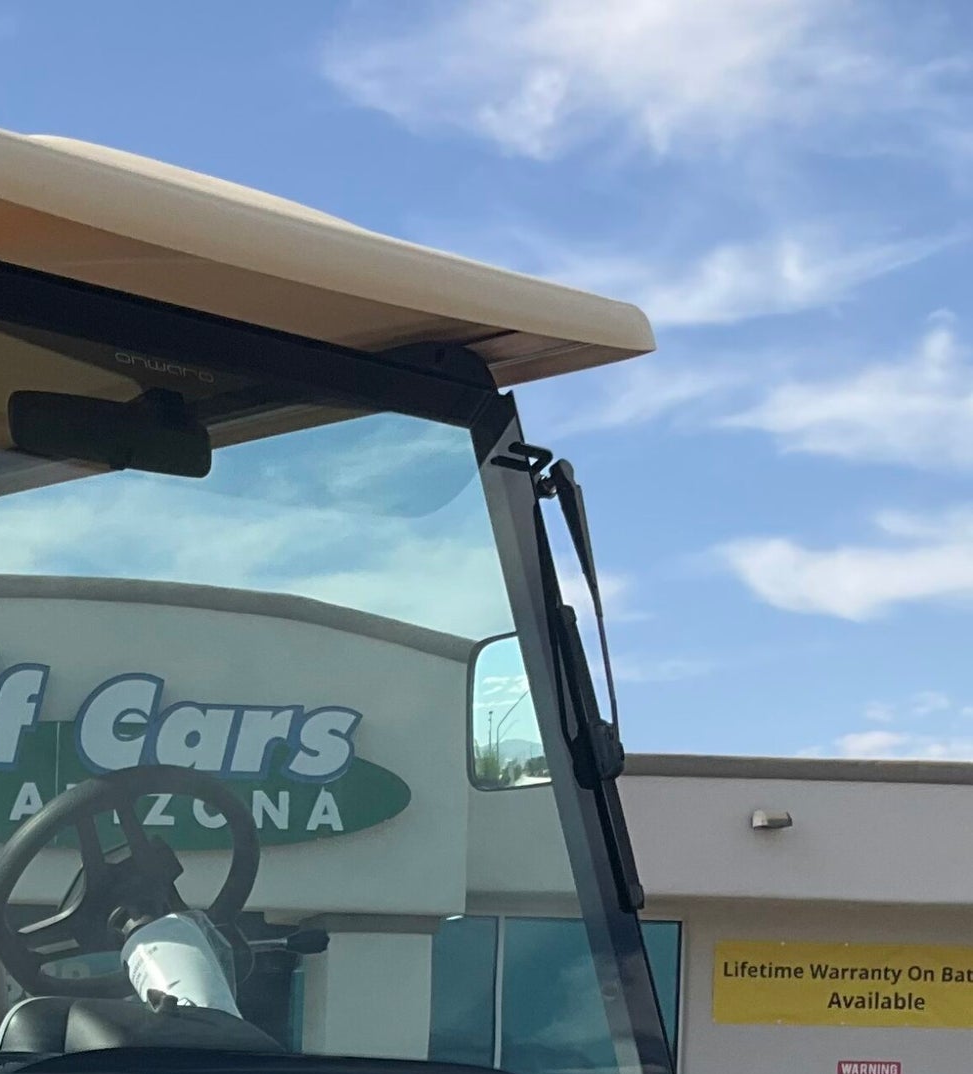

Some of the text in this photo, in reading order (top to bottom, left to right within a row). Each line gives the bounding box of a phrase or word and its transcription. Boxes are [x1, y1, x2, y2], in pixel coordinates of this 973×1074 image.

[75, 672, 364, 784] Cars
[723, 961, 804, 980] Lifetime
[810, 963, 902, 985] Warranty
[907, 965, 935, 982] On
[827, 991, 926, 1011] Available
